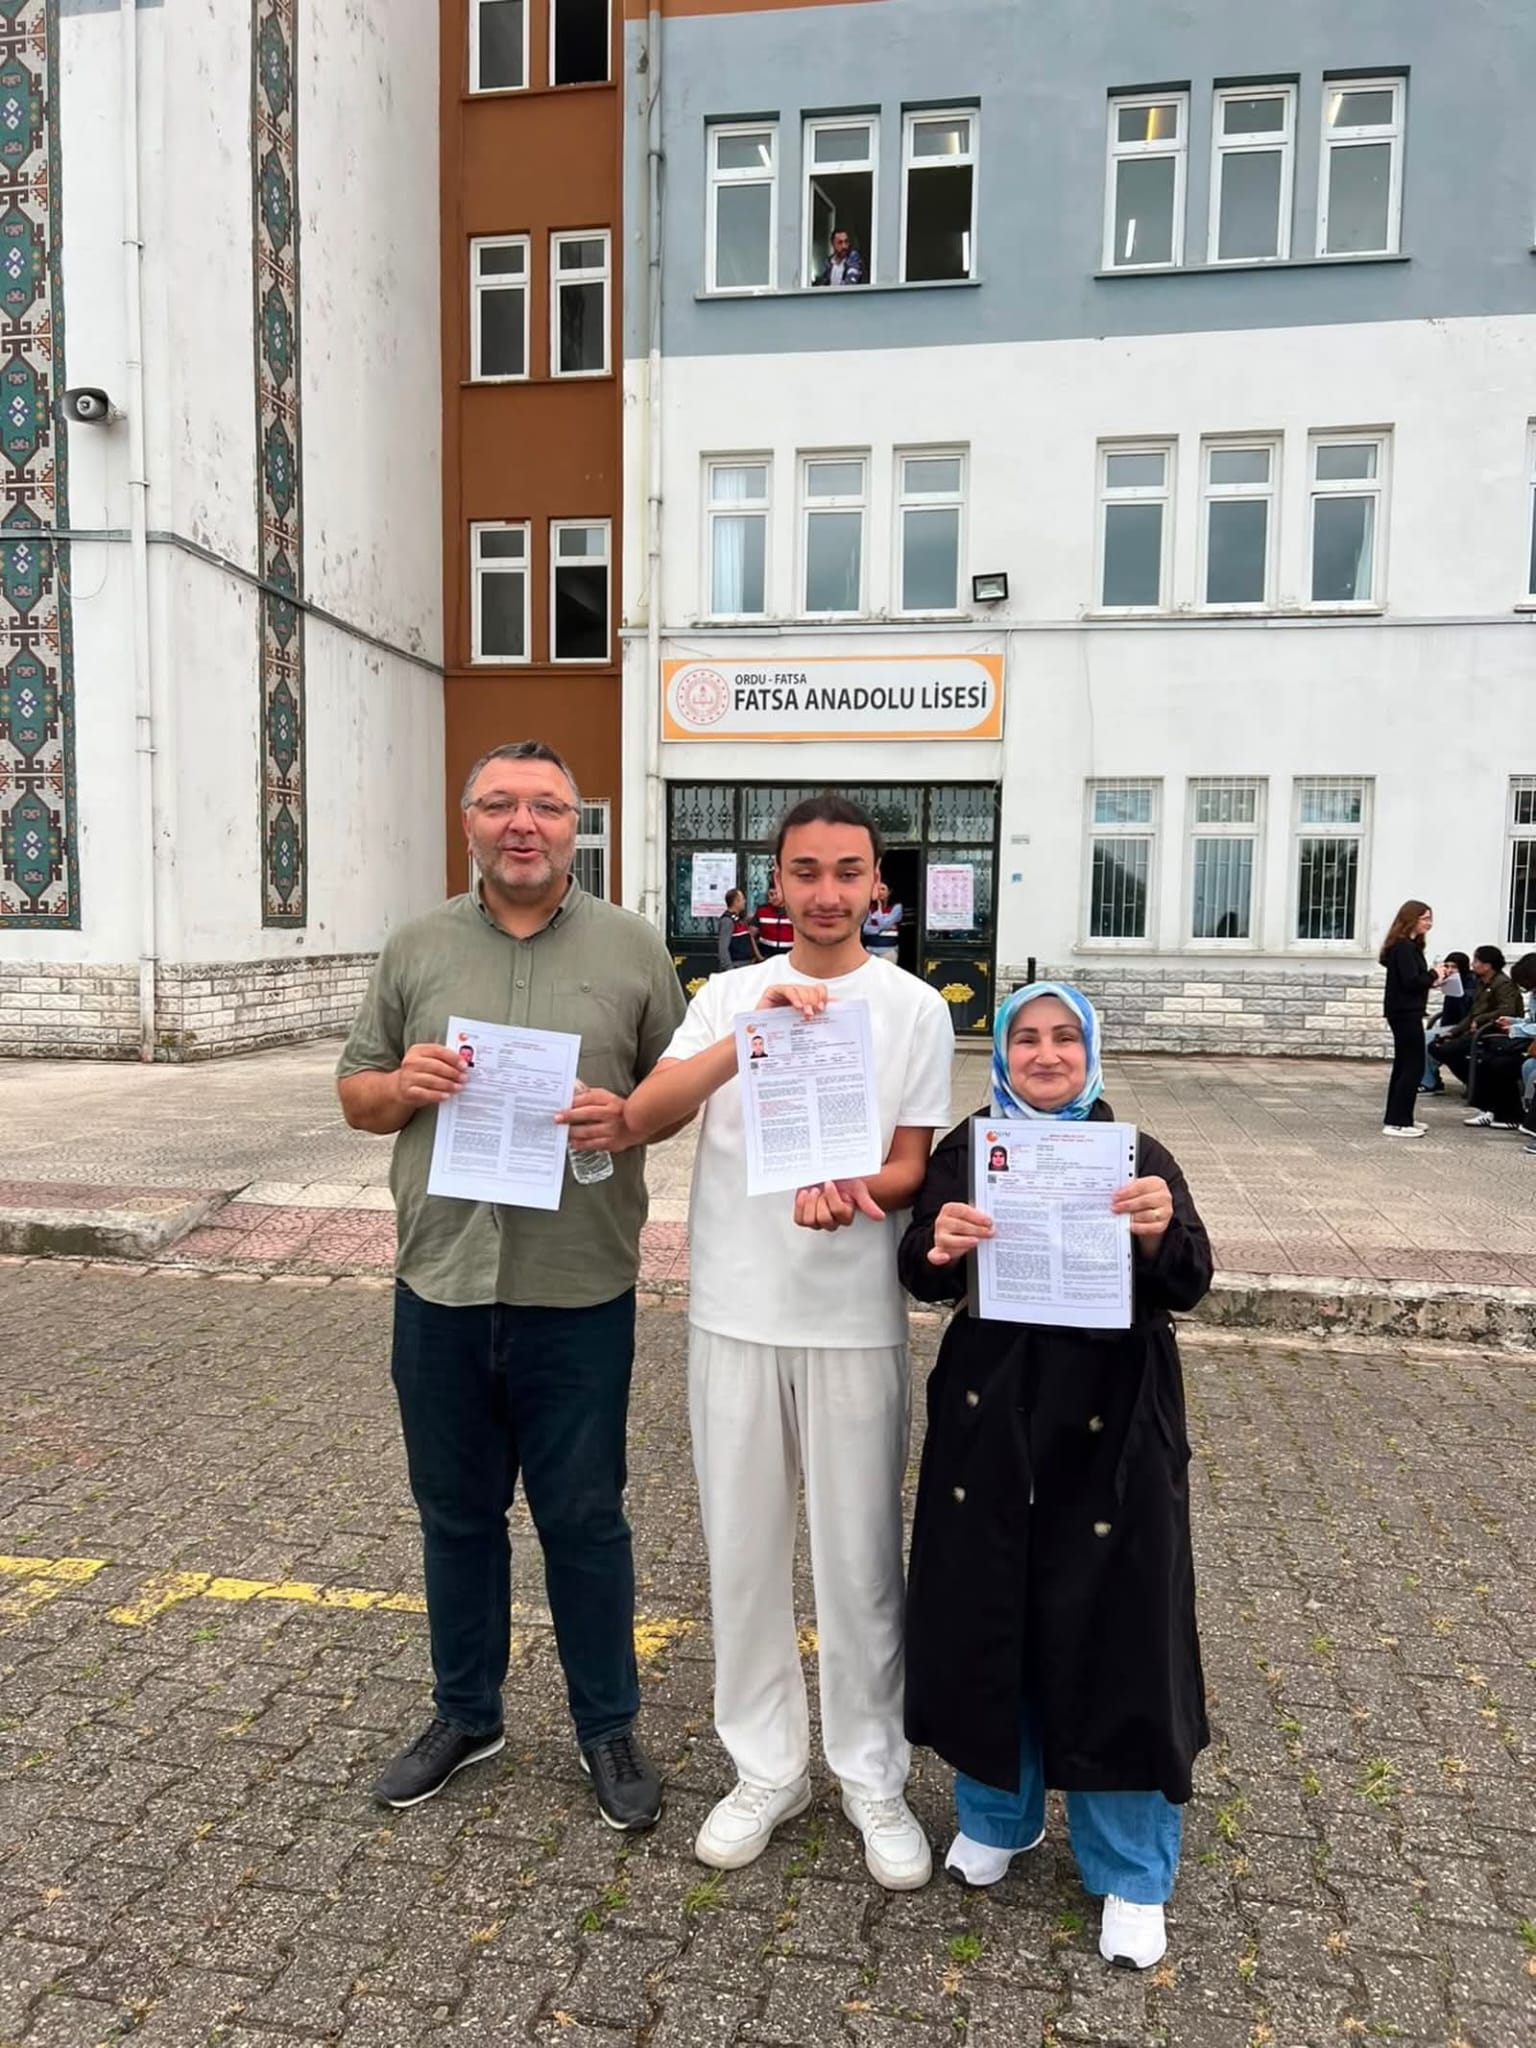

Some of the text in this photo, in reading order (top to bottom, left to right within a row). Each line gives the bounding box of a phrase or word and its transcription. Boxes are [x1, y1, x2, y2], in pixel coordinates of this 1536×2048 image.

[735, 674, 766, 685] ORDU
[775, 673, 807, 685] FATSA
[735, 688, 799, 711] FATSA
[805, 687, 914, 710] ANADOLU
[921, 681, 987, 709] LİSESİ
